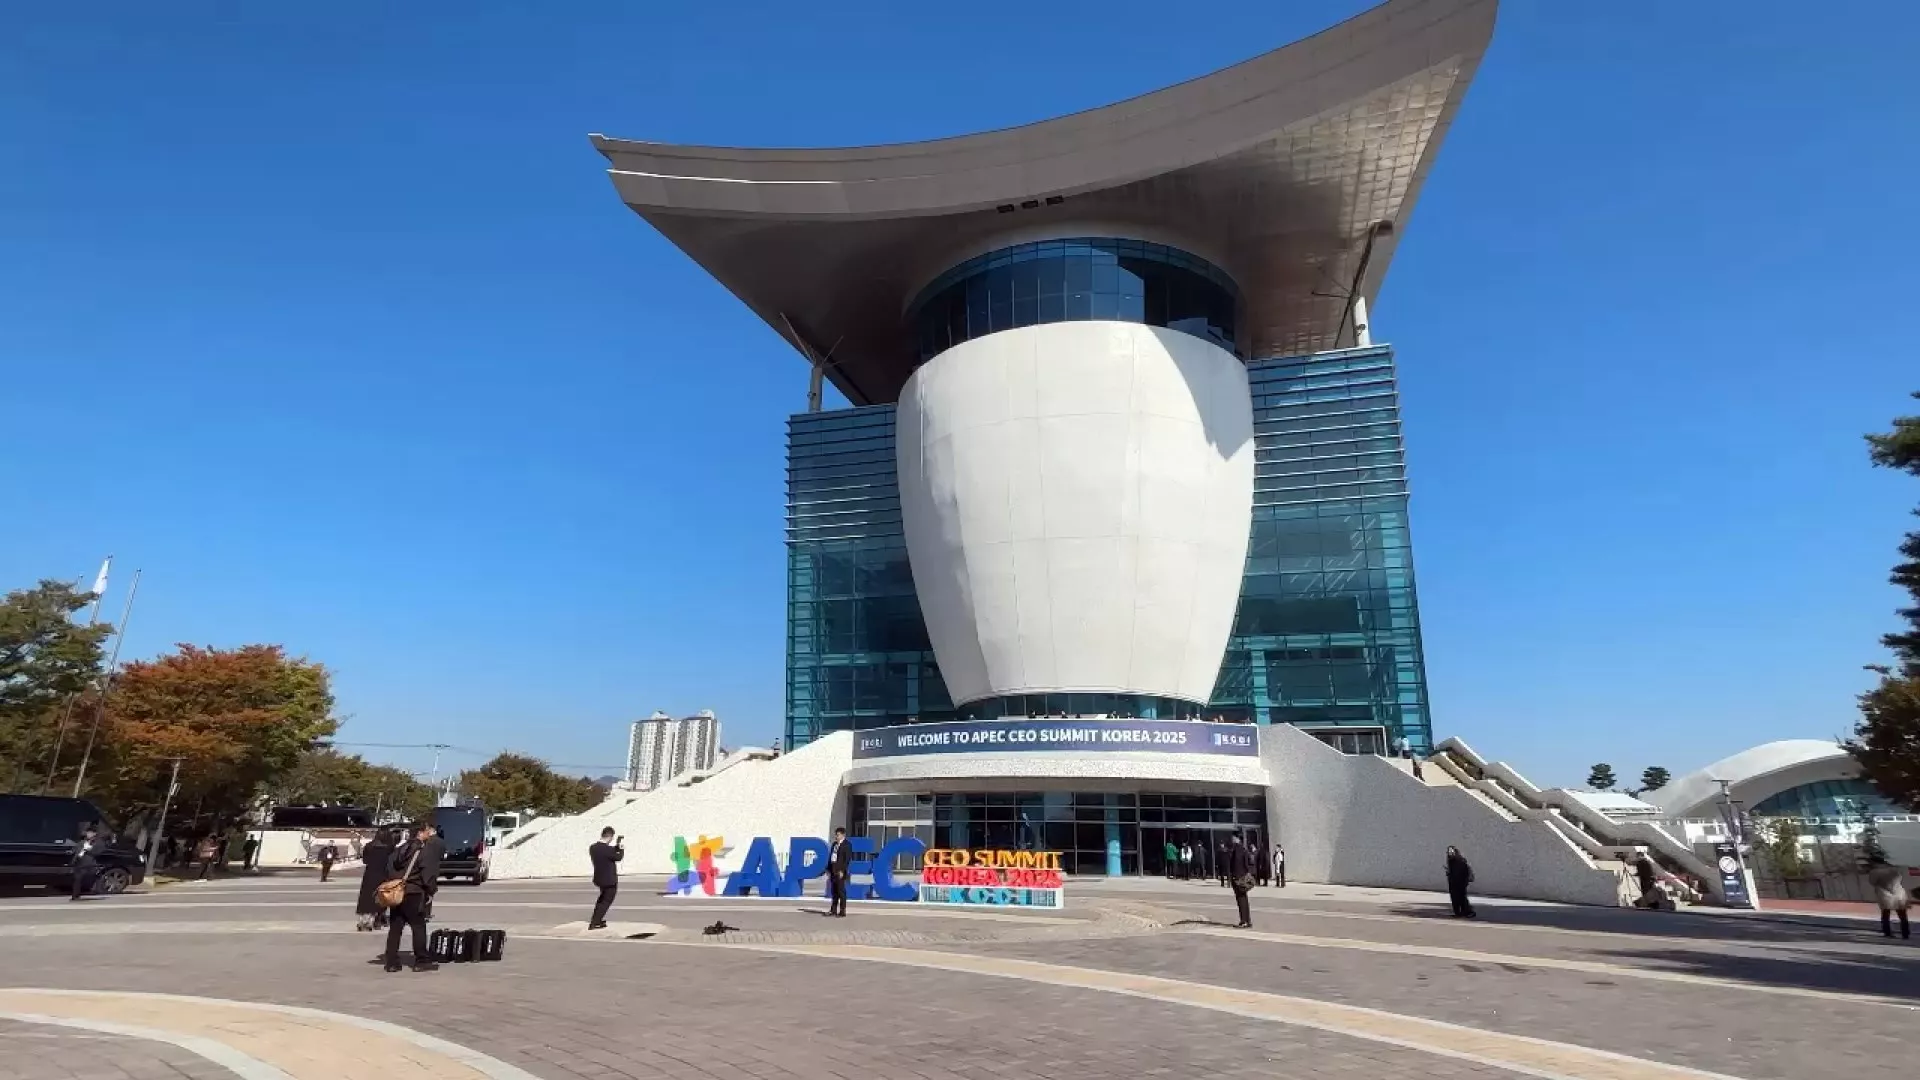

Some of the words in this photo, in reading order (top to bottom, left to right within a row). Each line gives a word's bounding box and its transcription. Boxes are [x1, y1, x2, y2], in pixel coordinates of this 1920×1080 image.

[898, 733, 950, 747] WELCOME
[952, 731, 969, 743] TO
[971, 730, 1006, 743] APEC
[1009, 730, 1037, 742] CEO
[1040, 729, 1098, 742] SUMMIT
[1102, 729, 1151, 743] KOREA
[1153, 731, 1187, 744] 2025
[723, 836, 926, 901] APEC
[924, 849, 970, 867] CEO
[974, 850, 1064, 870] SUMMIT
[923, 867, 999, 886] KOREA
